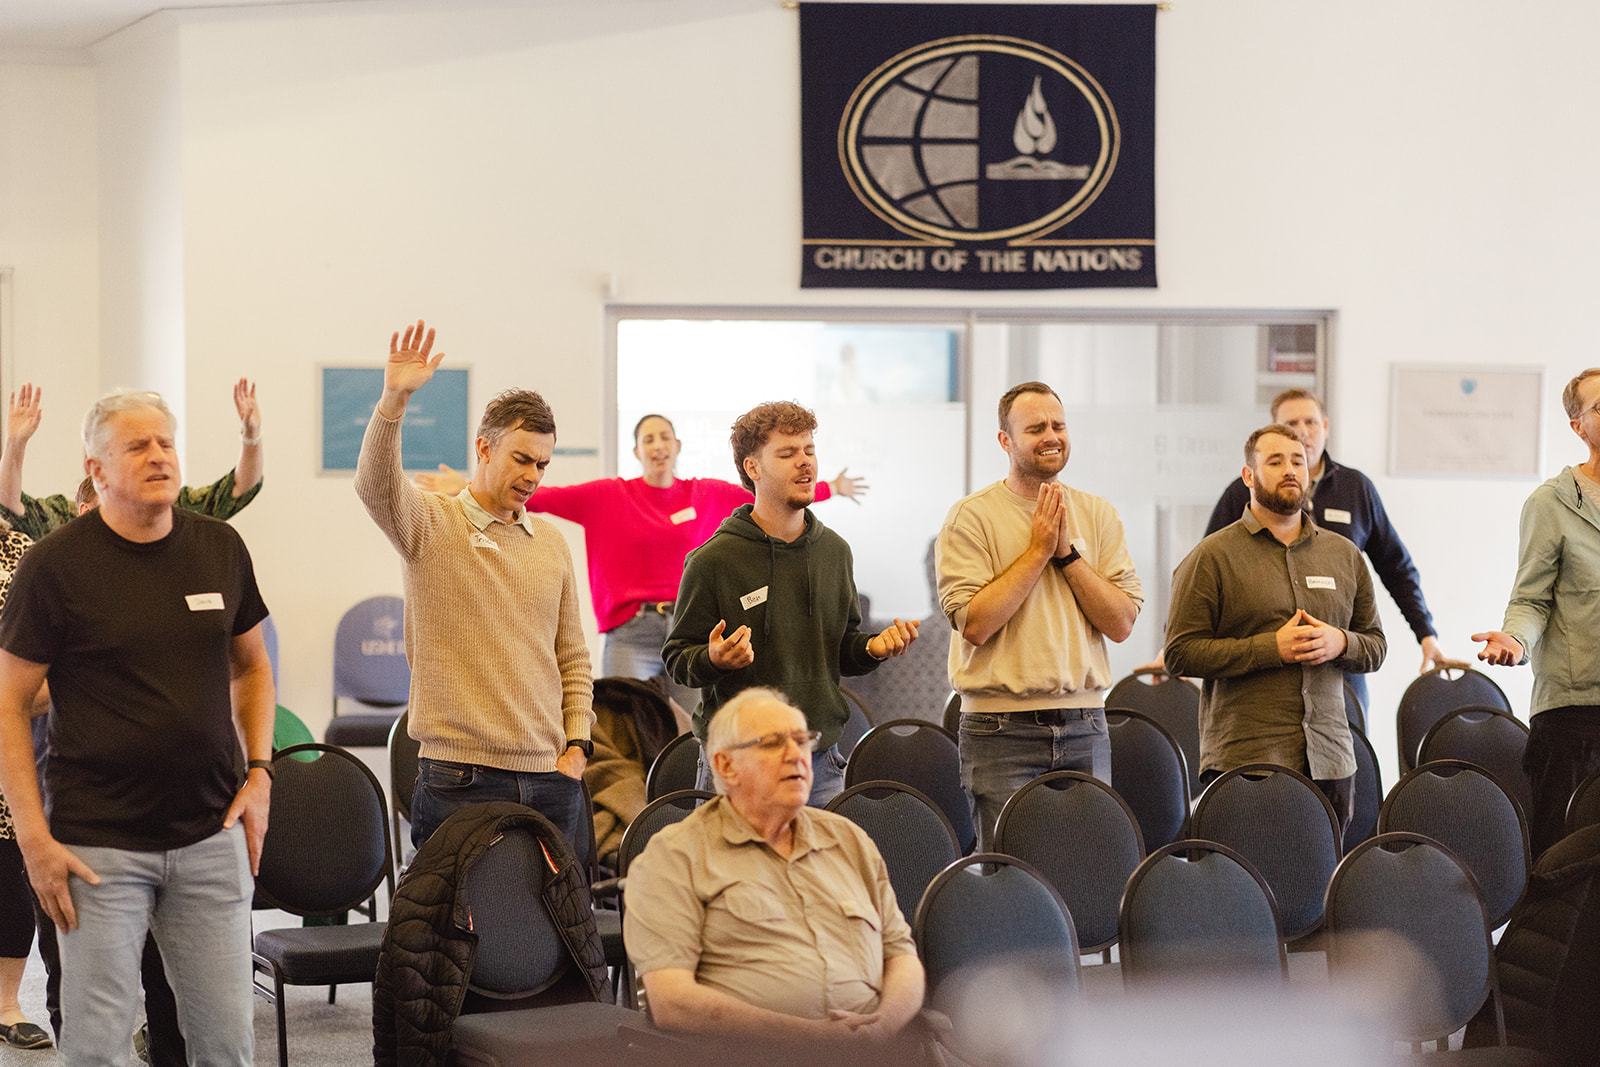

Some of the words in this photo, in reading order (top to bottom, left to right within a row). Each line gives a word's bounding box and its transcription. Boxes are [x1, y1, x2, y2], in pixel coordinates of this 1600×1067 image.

[814, 248, 925, 271] CHURCH
[931, 249, 968, 271] OF
[975, 250, 1026, 272] THE
[1032, 249, 1143, 272] NATIONS
